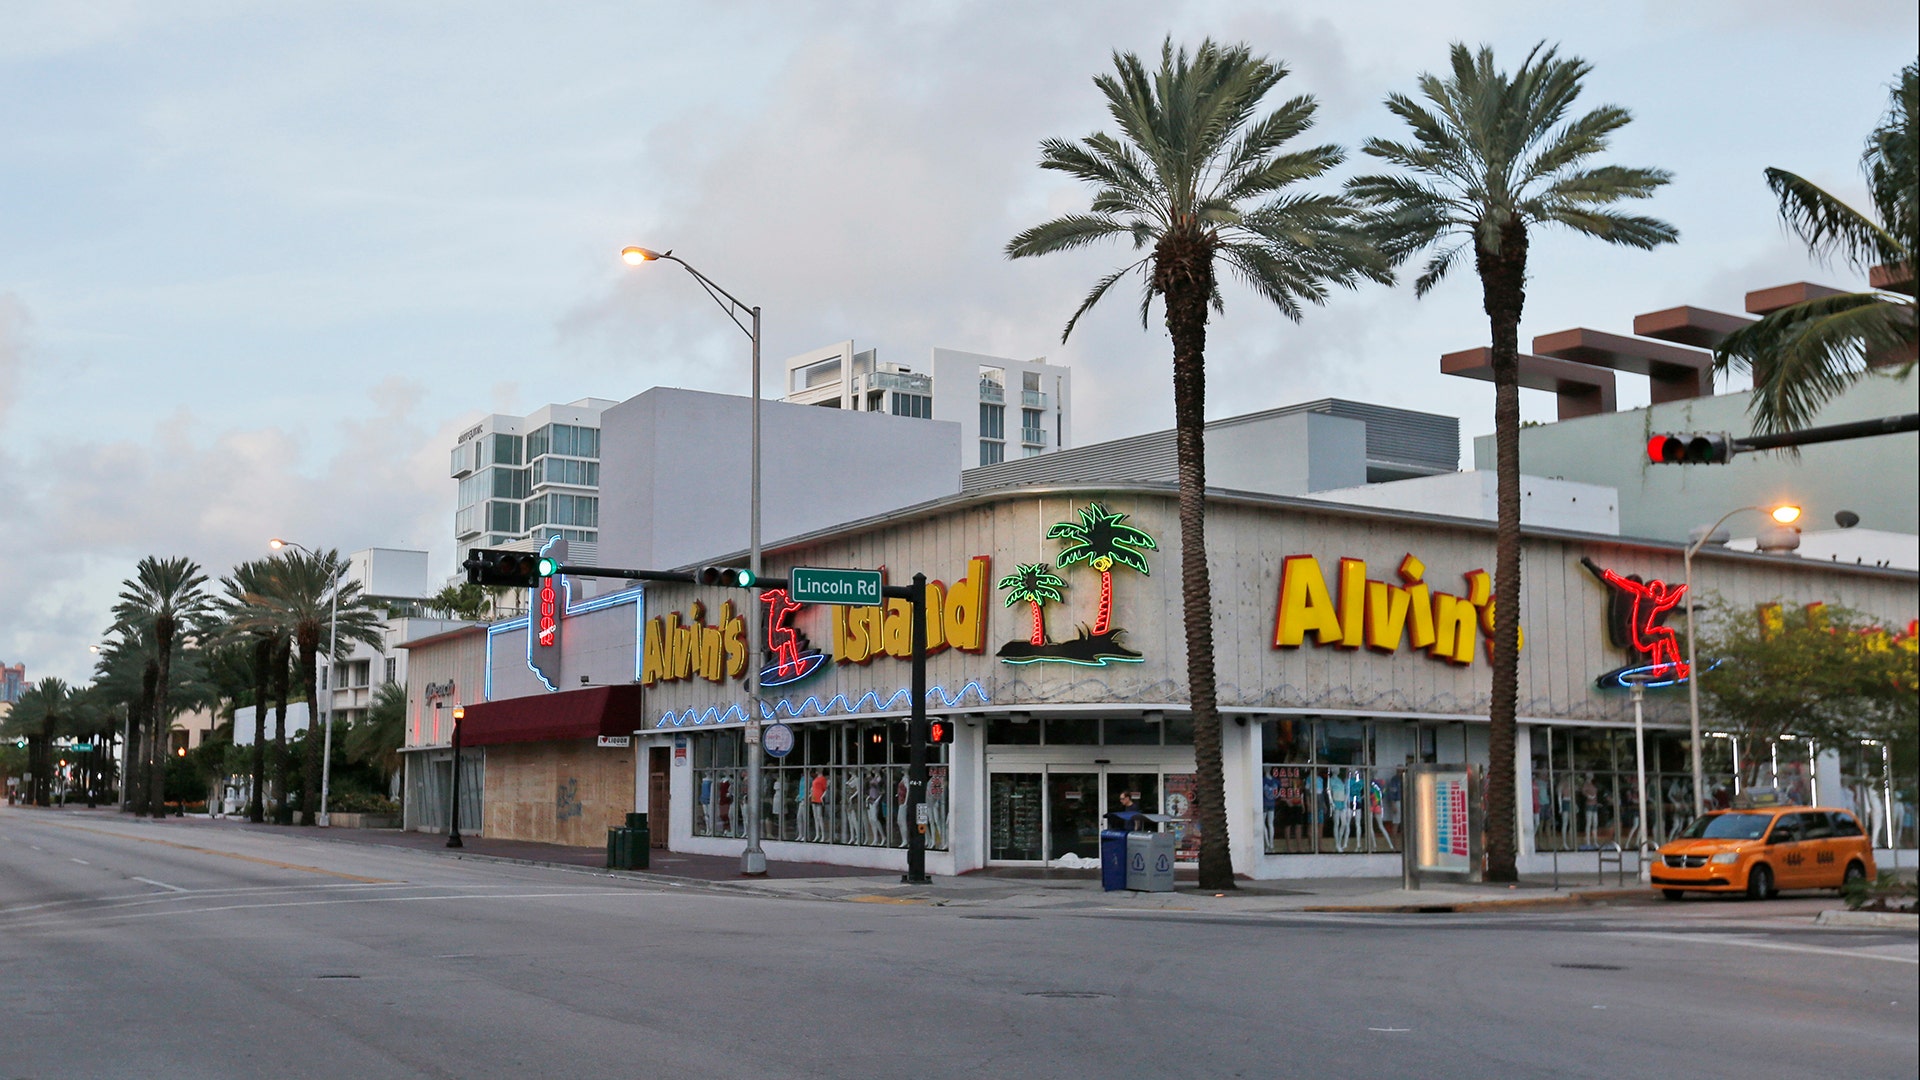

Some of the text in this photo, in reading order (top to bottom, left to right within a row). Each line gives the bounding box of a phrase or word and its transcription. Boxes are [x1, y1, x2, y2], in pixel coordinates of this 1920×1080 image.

[798, 577, 876, 596] Lincoln Rd
[642, 598, 746, 688] Alvin's
[1272, 767, 1300, 778] SALE
